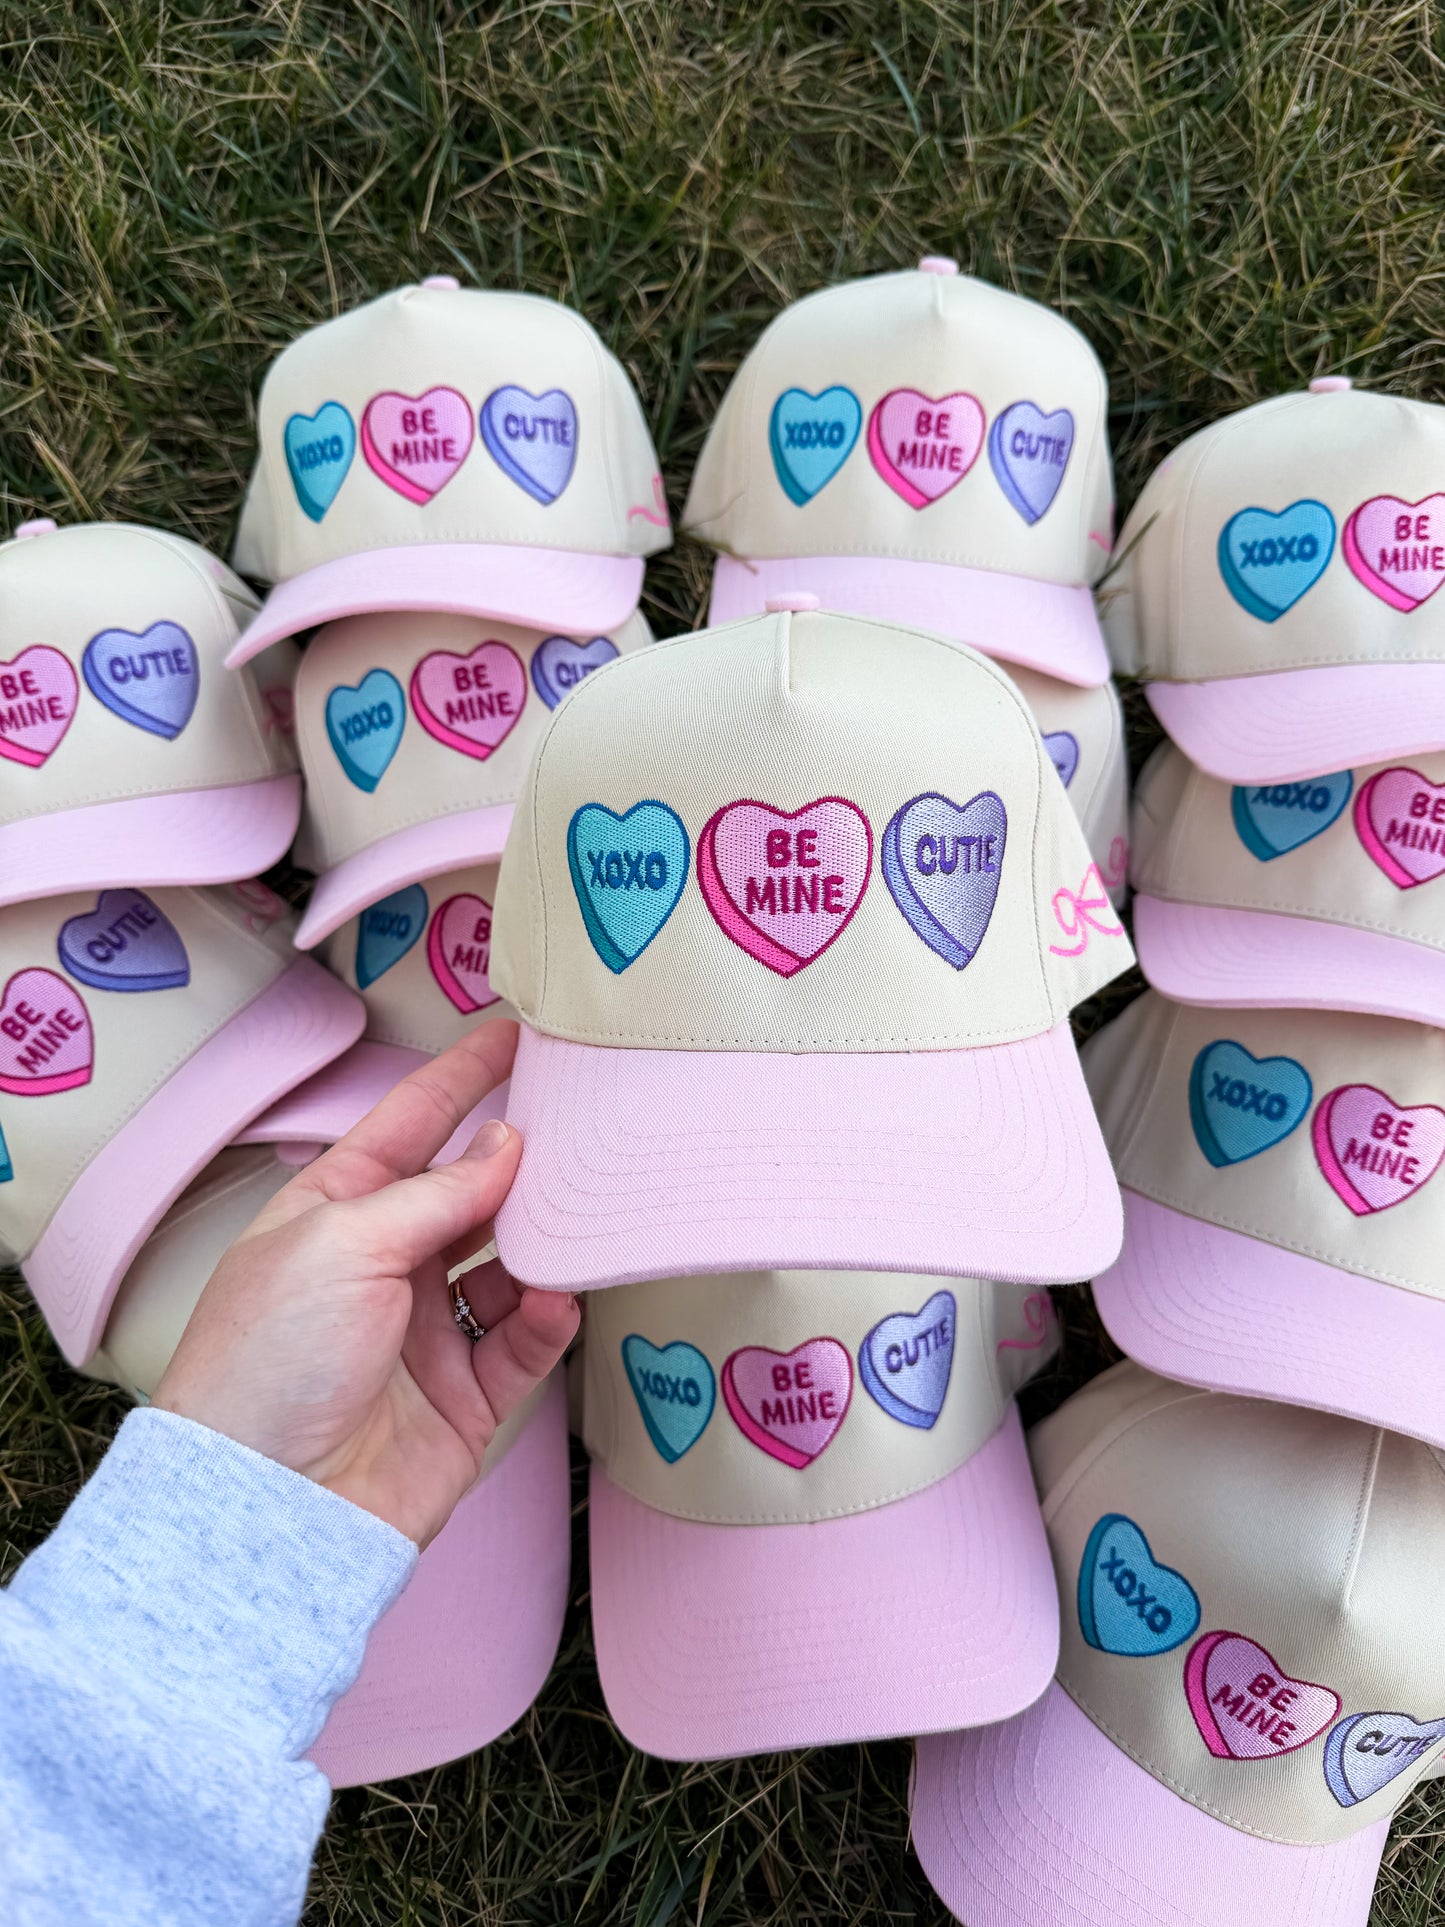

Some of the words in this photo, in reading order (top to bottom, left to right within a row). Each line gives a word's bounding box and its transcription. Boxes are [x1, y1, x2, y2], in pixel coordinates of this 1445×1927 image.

[402, 409, 438, 435] BE
[505, 413, 571, 449] CUTIE
[784, 420, 846, 449] XOXO
[915, 411, 949, 440] BE
[294, 434, 344, 471] XOXO
[391, 437, 459, 466] MINE
[897, 442, 963, 472] MINE
[1011, 430, 1065, 466] CUTIE
[1395, 515, 1430, 541] BE
[1239, 533, 1319, 569] XOXO
[1378, 545, 1445, 573] MINE
[0, 670, 41, 699] BE
[109, 648, 191, 685] CUTIE
[453, 664, 493, 693] BE
[0, 697, 68, 732] MINE
[338, 701, 395, 746] XOXO
[445, 692, 517, 726] MINE
[1409, 791, 1445, 824] BE
[765, 828, 819, 869] BE
[916, 833, 998, 877] CUTIE
[587, 850, 667, 892] XOXO
[745, 874, 846, 917] MINE
[86, 903, 157, 963] CUTIE
[0, 1001, 45, 1042] BE
[16, 1007, 84, 1075] MINE
[1207, 1071, 1288, 1122] XOXO
[1370, 1112, 1414, 1148] BE
[1342, 1138, 1420, 1185] MINE
[885, 1316, 952, 1375] CUTIE
[638, 1366, 701, 1408] XOXO
[772, 1362, 814, 1394] BE
[760, 1390, 837, 1428] MINE
[1100, 1545, 1172, 1635] XOXO
[1247, 1672, 1299, 1713] BE
[1211, 1683, 1298, 1746] MINE
[1355, 1729, 1438, 1758] CUTIE
